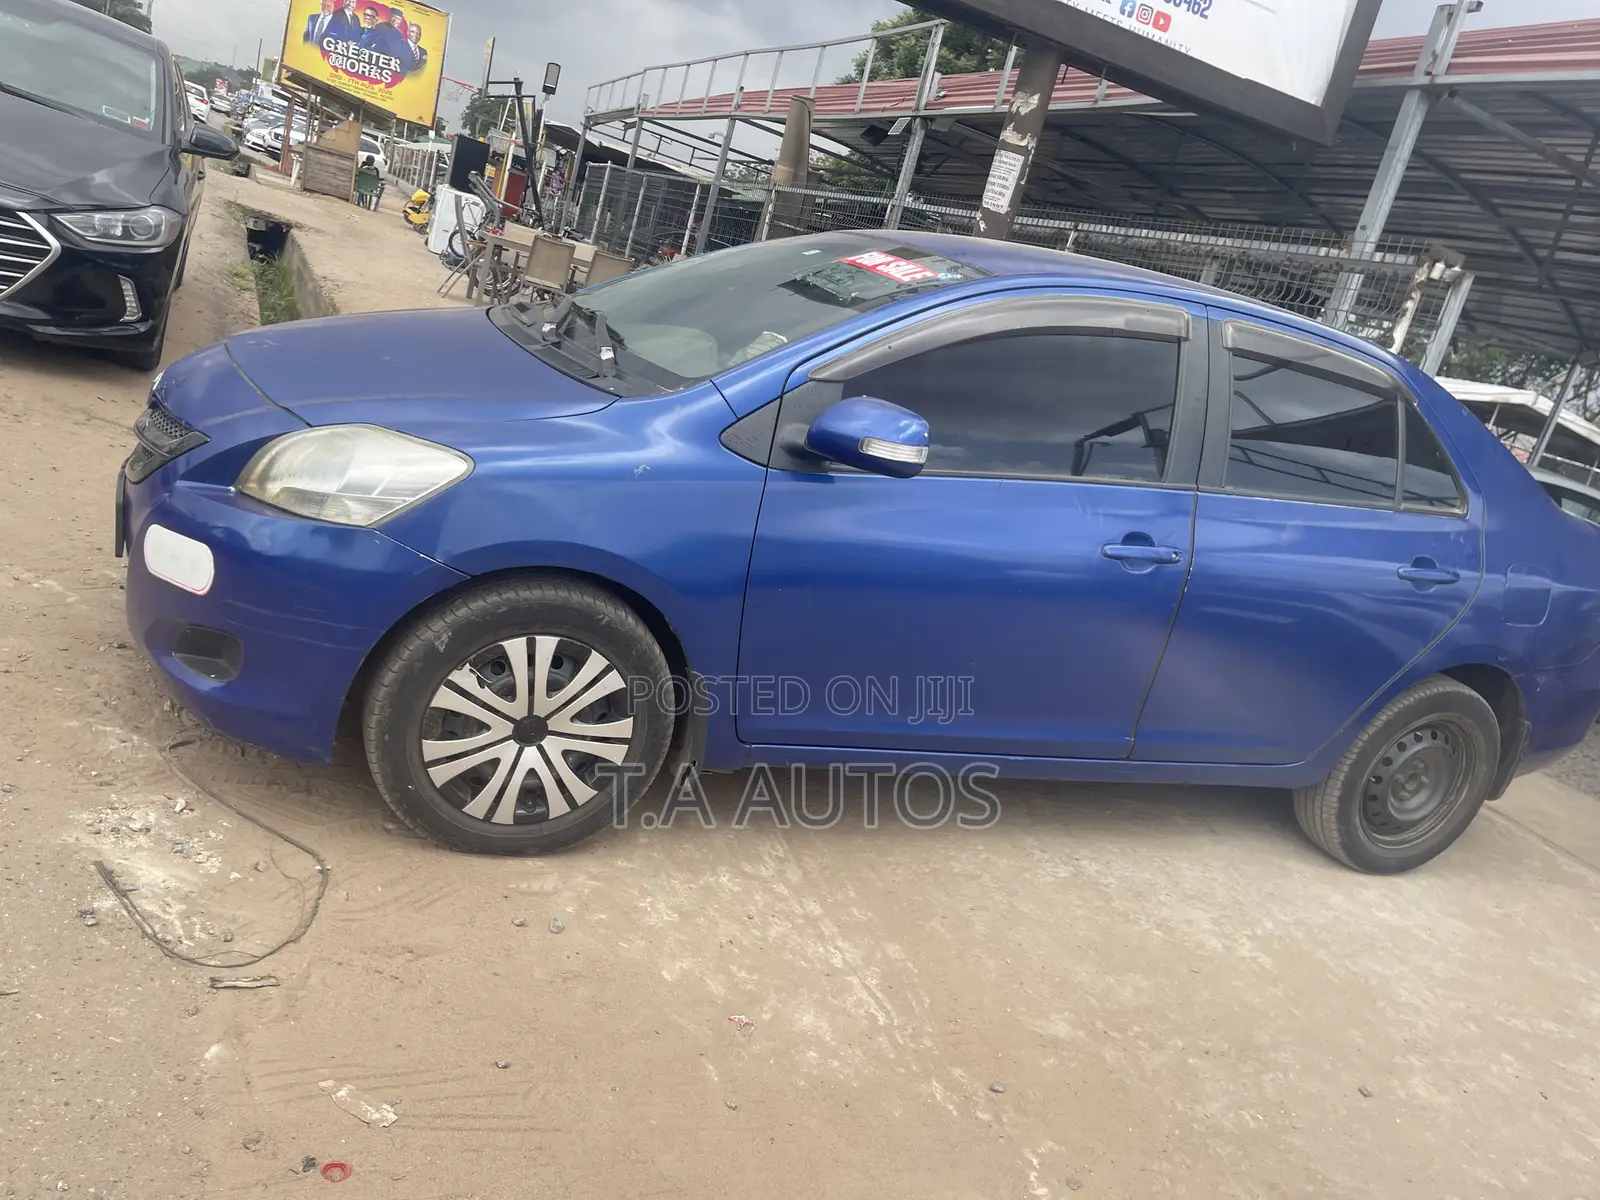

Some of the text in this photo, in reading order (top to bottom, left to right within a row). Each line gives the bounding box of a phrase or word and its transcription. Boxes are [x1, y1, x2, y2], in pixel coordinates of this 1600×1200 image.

[323, 37, 401, 72] GREATER
[329, 52, 392, 83] WORKS
[848, 251, 897, 267] FOR
[875, 260, 936, 282] SALE
